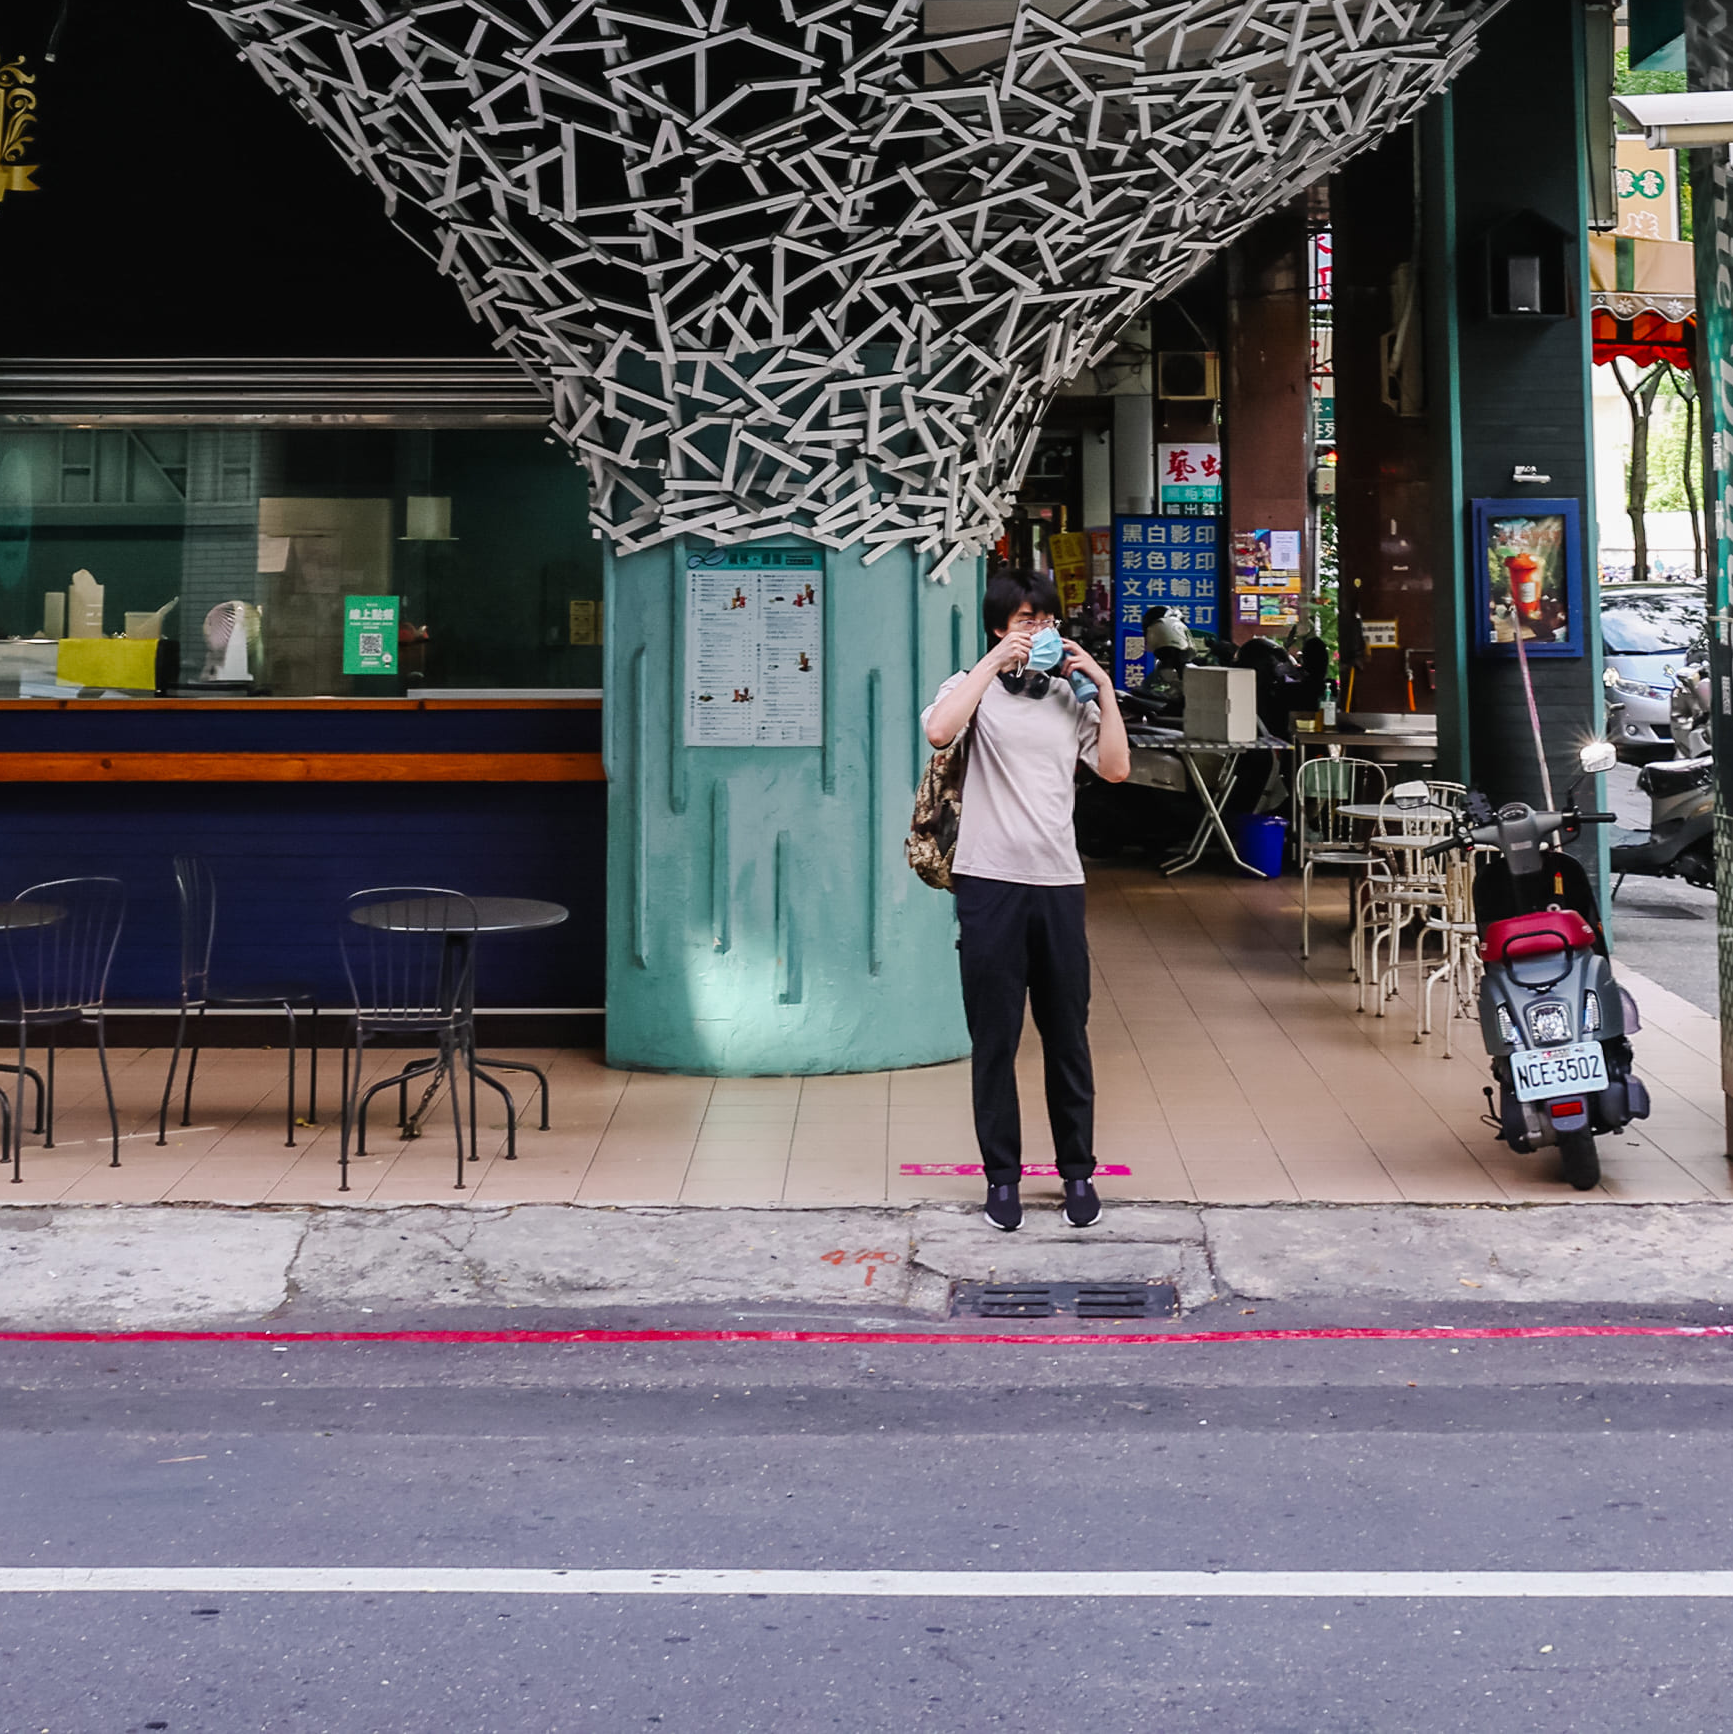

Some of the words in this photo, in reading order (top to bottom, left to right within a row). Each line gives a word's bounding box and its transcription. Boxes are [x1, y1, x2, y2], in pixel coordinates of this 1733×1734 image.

[1122, 524, 1216, 544] 黑白影印
[1122, 551, 1216, 570] 彩色影印
[1122, 578, 1215, 598] 文件輸出
[1122, 604, 1215, 624] 活裝訂
